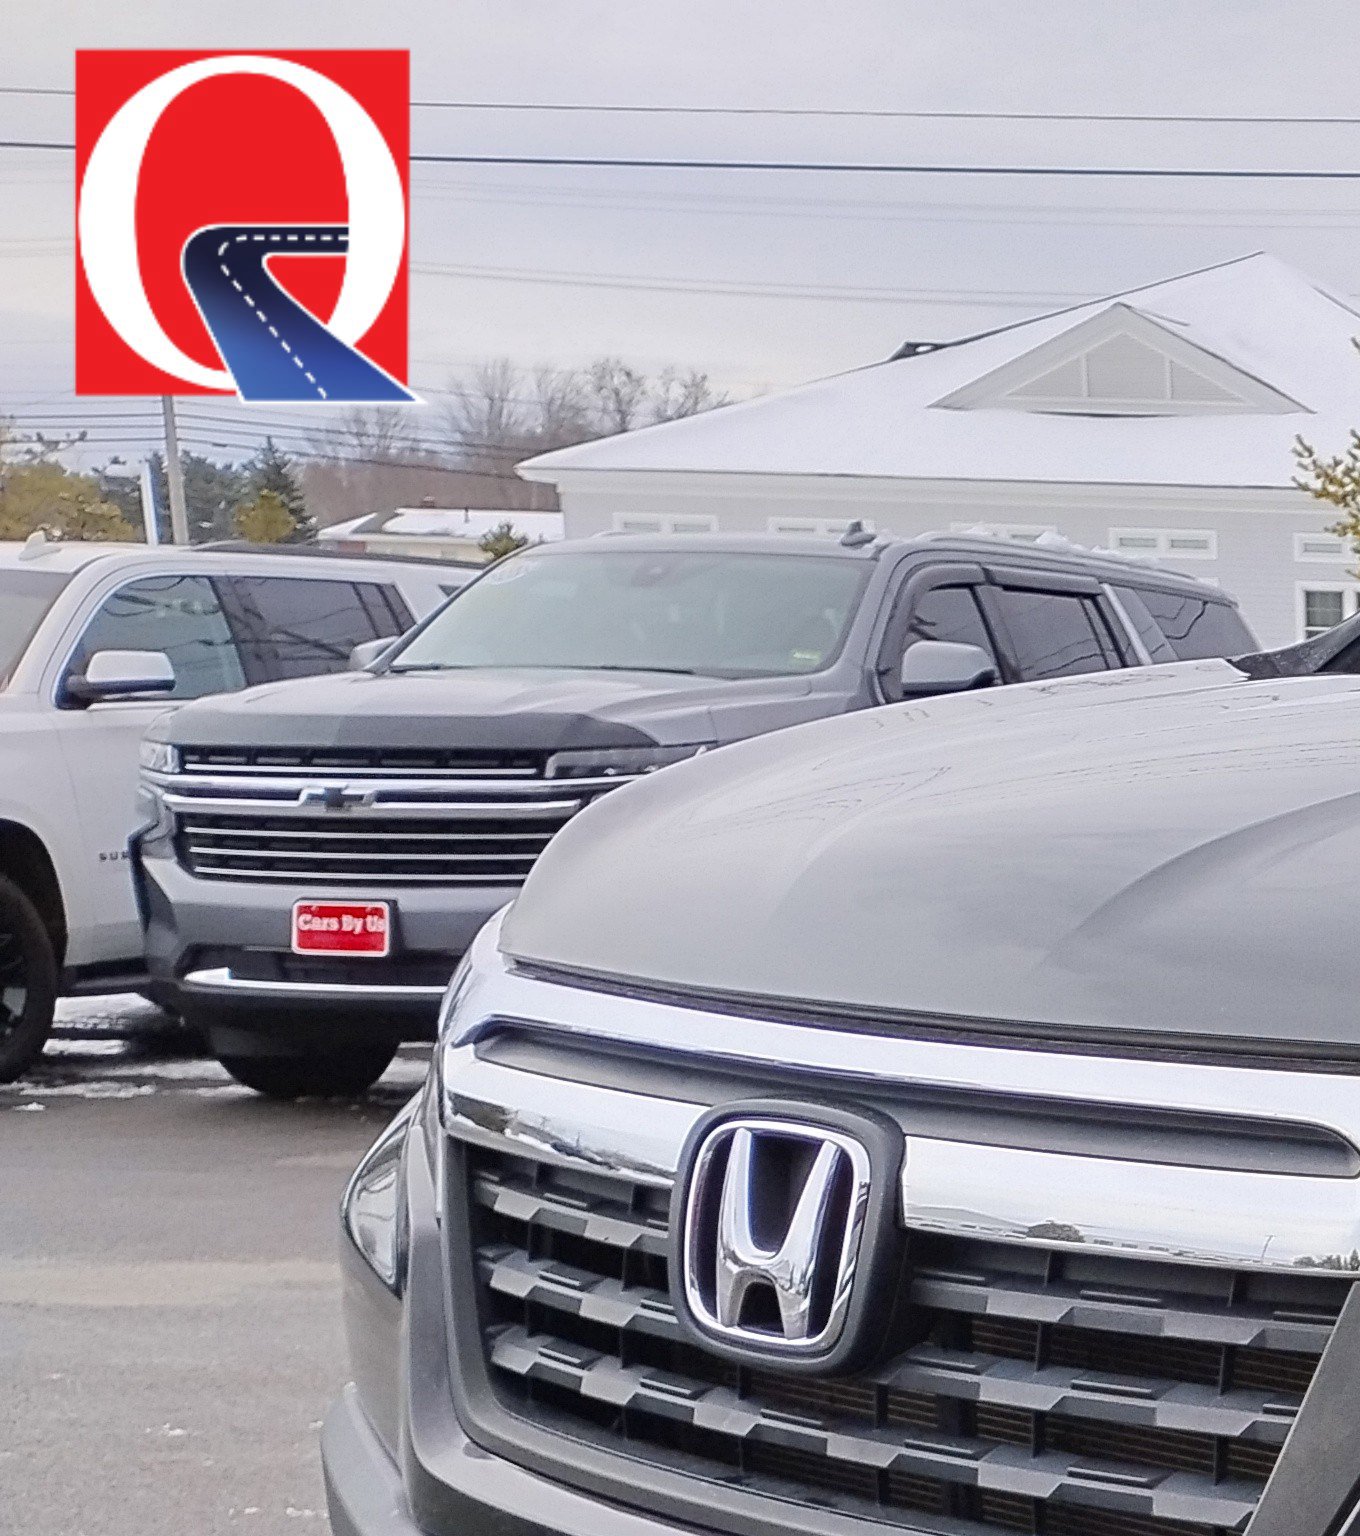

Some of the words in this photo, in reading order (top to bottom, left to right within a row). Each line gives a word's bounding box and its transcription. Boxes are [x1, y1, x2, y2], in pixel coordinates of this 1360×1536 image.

[299, 913, 339, 932] Cars
[341, 913, 364, 935] By
[366, 914, 386, 933] Us
